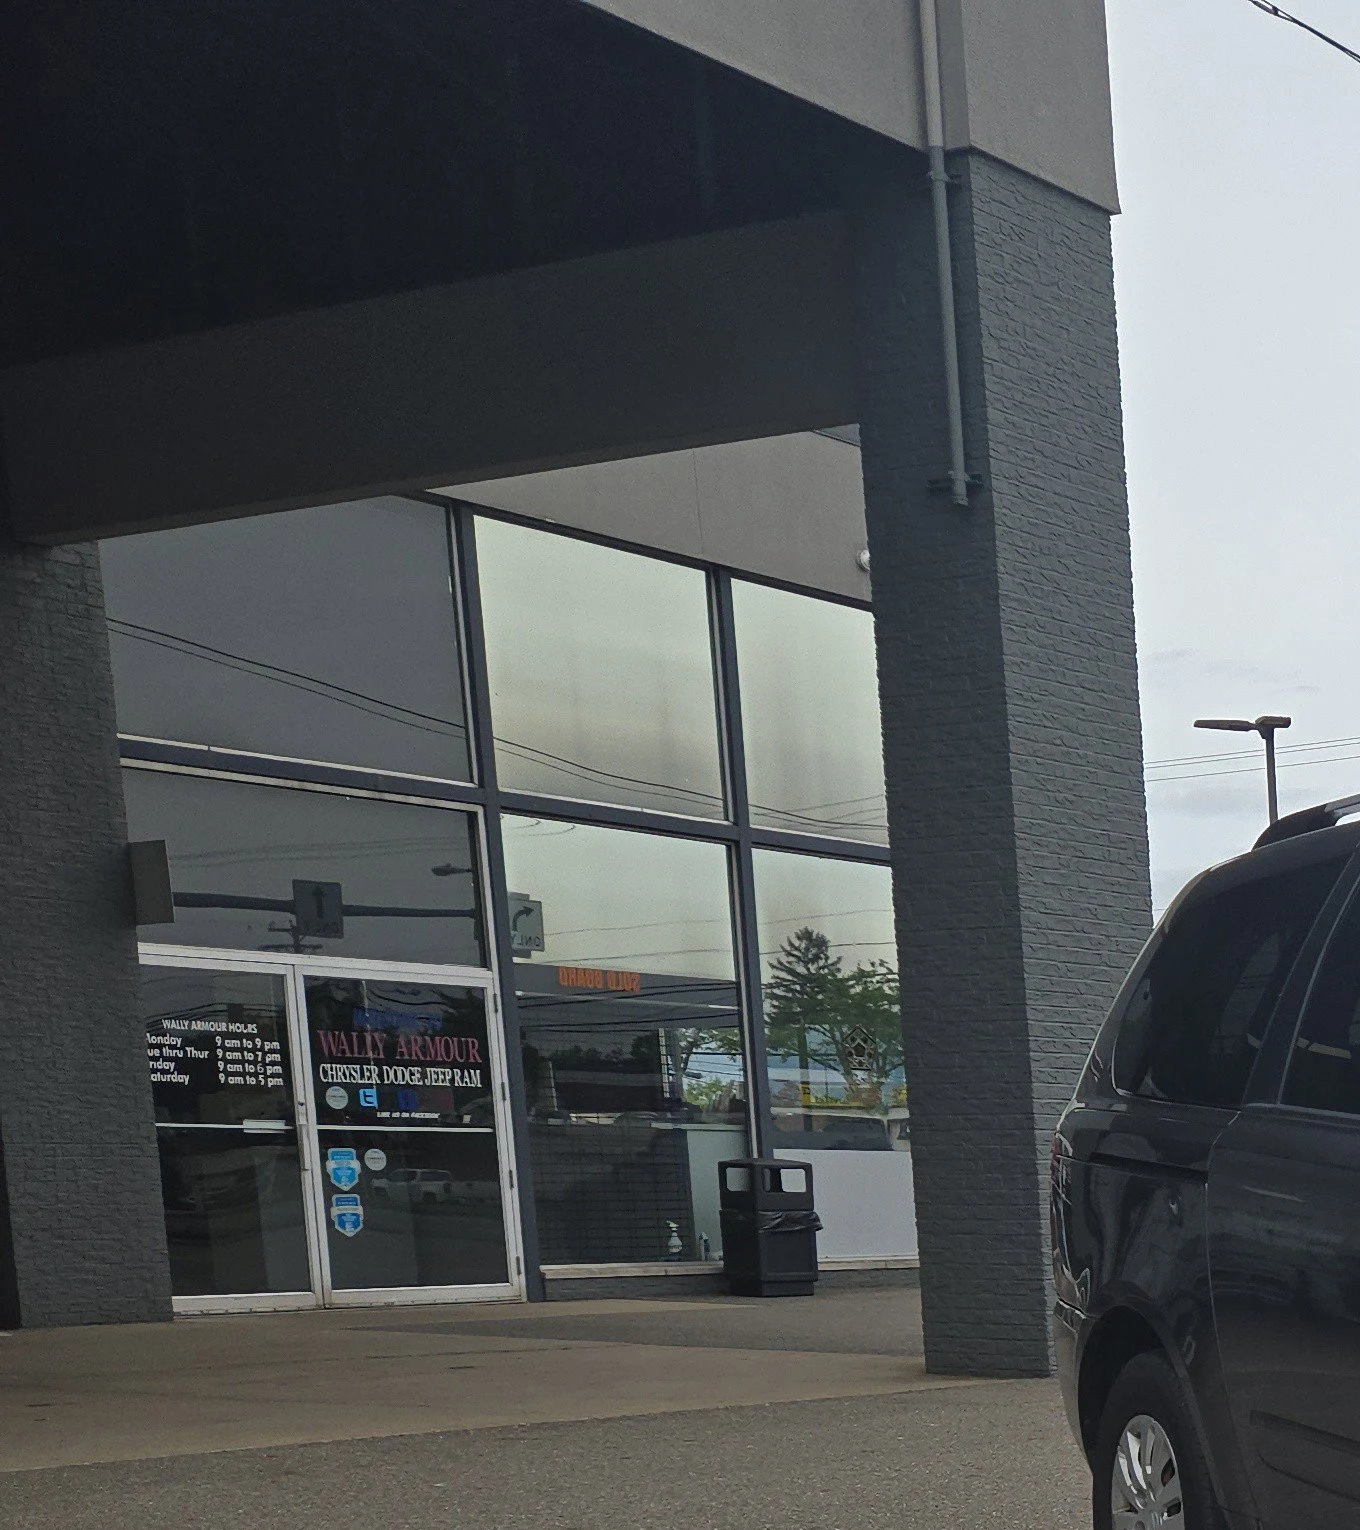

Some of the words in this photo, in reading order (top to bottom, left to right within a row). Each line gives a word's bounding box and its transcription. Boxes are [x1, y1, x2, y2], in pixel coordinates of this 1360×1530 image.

[162, 1019, 189, 1030] WALLY
[191, 1020, 227, 1031] ARMOUR
[228, 1022, 257, 1033] HOURS
[215, 1035, 222, 1046] 9
[225, 1039, 240, 1047] am
[243, 1038, 253, 1048] to
[255, 1037, 261, 1048] 9
[264, 1041, 280, 1051] pm
[317, 1029, 387, 1060] WALLY
[395, 1033, 483, 1063] ARMOUR
[147, 1048, 160, 1056] ue
[162, 1045, 184, 1057] thru
[185, 1047, 210, 1058] Thur
[216, 1048, 223, 1059] 9
[225, 1051, 242, 1060] am
[243, 1050, 254, 1060] to
[256, 1051, 262, 1062] 7
[265, 1053, 281, 1064] pm
[149, 1058, 175, 1072] riday
[217, 1061, 224, 1072] 9
[227, 1064, 243, 1072] am
[245, 1062, 255, 1073] to
[256, 1063, 264, 1073] 6
[266, 1065, 282, 1076] pm
[150, 1070, 190, 1086] aturday
[218, 1072, 225, 1084] 9
[227, 1076, 244, 1084] am
[245, 1075, 256, 1085] to
[258, 1074, 265, 1086] 5
[267, 1078, 284, 1088] pm
[319, 1063, 381, 1085] CHRYSLER
[382, 1065, 423, 1086] DODGE
[424, 1067, 452, 1087] JEEP
[454, 1067, 482, 1088] RAM
